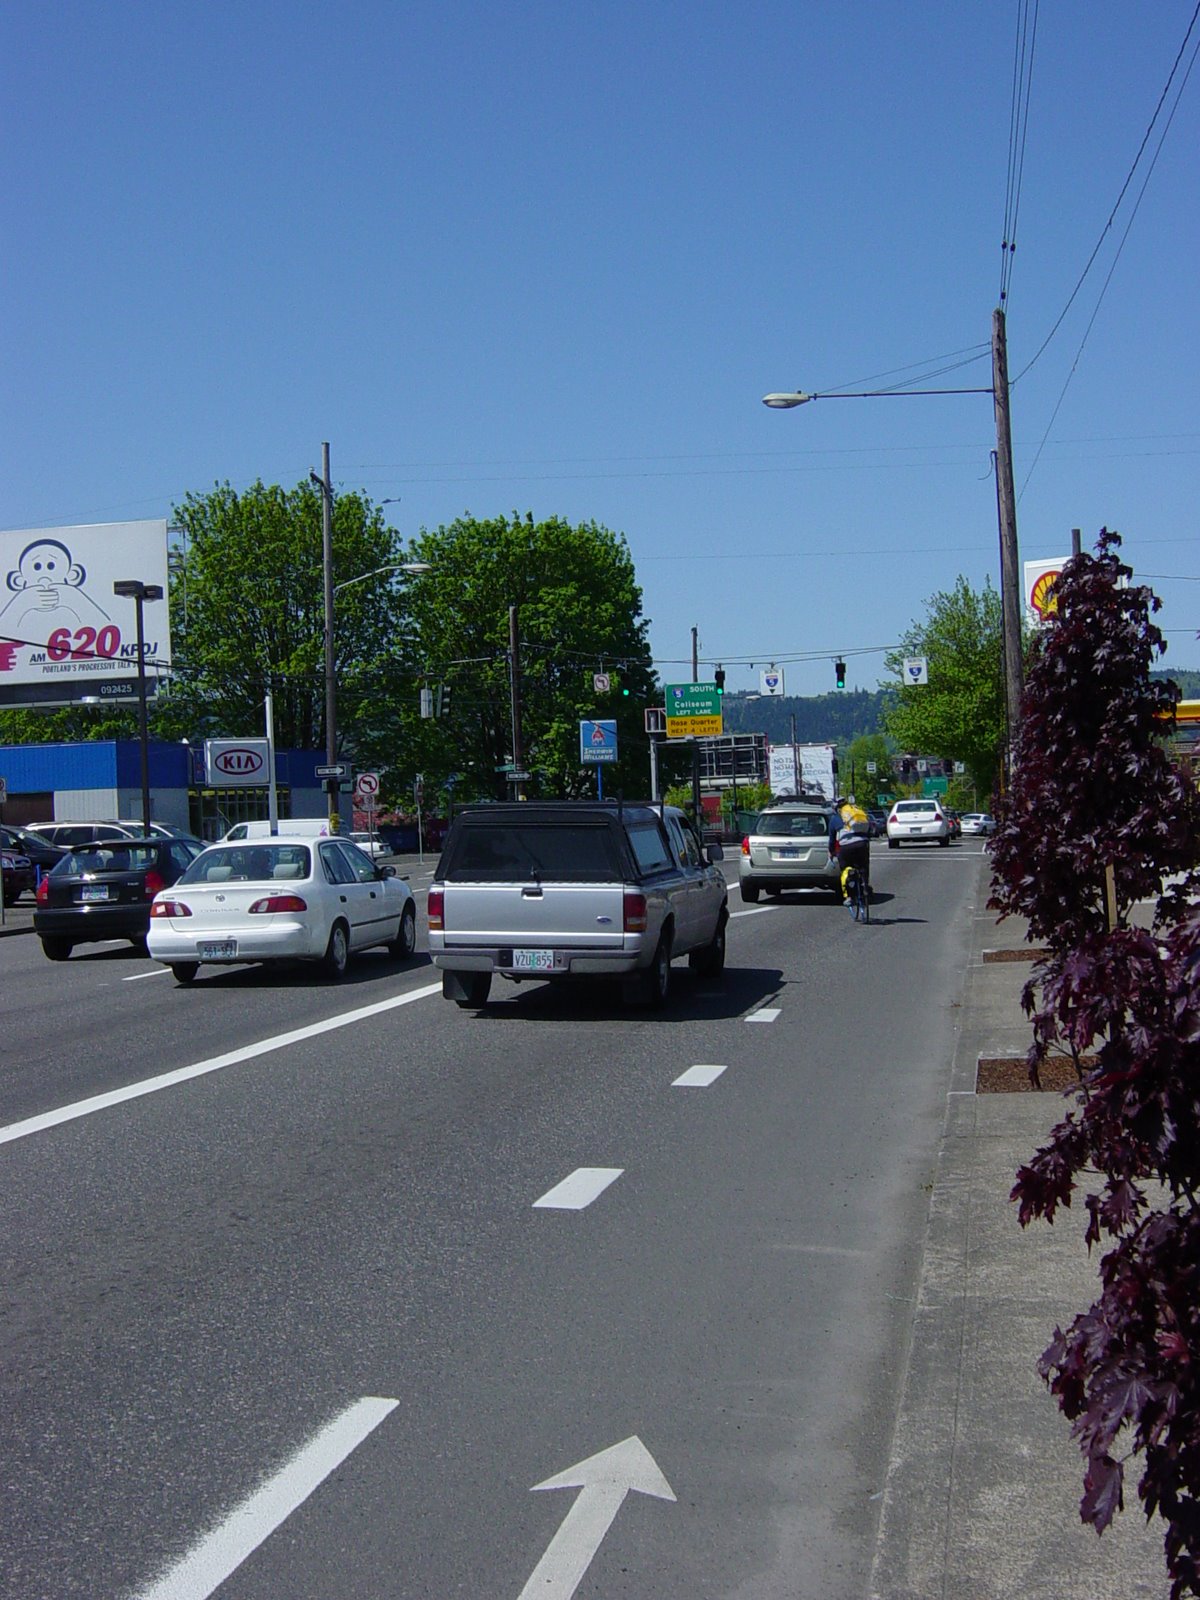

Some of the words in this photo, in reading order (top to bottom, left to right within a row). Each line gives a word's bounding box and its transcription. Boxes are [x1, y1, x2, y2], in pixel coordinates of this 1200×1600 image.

[29, 653, 46, 663] AM
[47, 624, 121, 661] 620
[120, 642, 158, 657] KPOJ
[42, 663, 77, 673] PORTLAND'S
[78, 661, 116, 671] PROGRESSIVE
[100, 684, 132, 694] 092425
[675, 690, 682, 698] 5
[689, 685, 715, 693] SOUTH
[223, 755, 256, 769] KIA
[515, 954, 531, 966] VZU
[536, 954, 552, 966] 855
